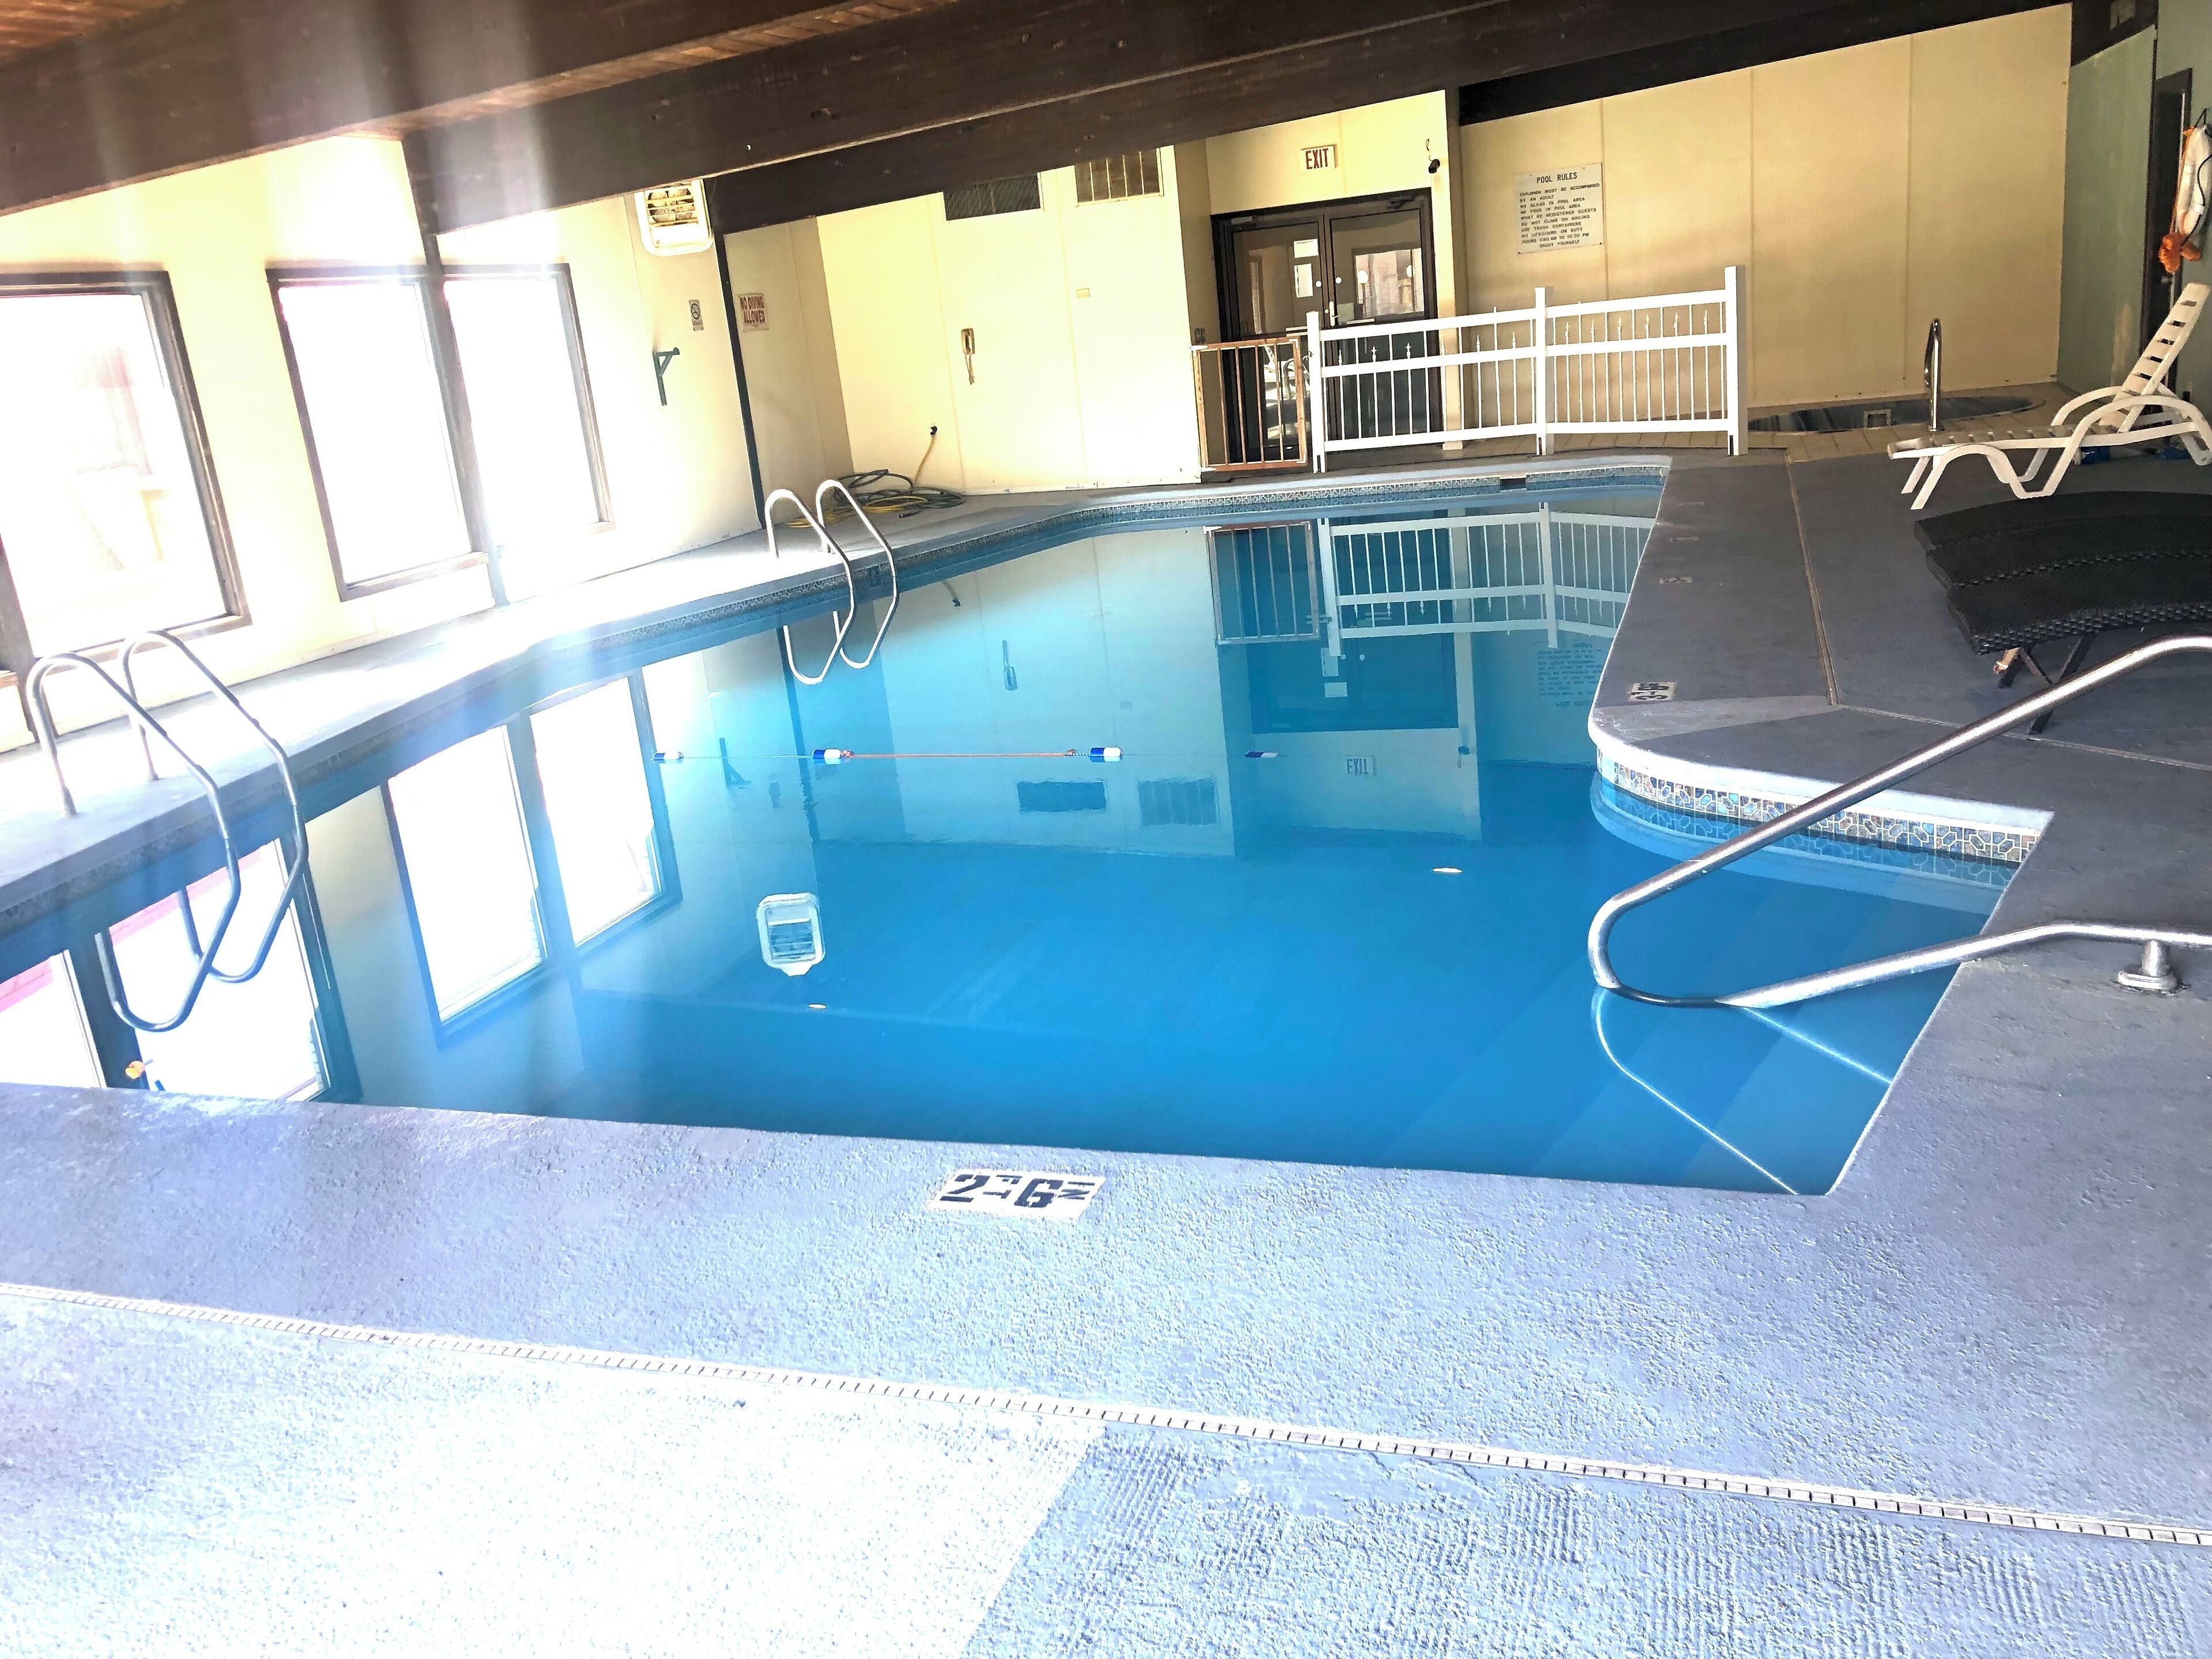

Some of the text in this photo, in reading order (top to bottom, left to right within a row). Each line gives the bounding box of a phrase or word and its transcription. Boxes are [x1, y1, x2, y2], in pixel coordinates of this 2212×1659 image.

[1305, 148, 1328, 169] EXIT
[1536, 172, 1577, 183] POOL RULES
[740, 296, 764, 310] NO DIVING
[743, 309, 766, 324] ALLOWED
